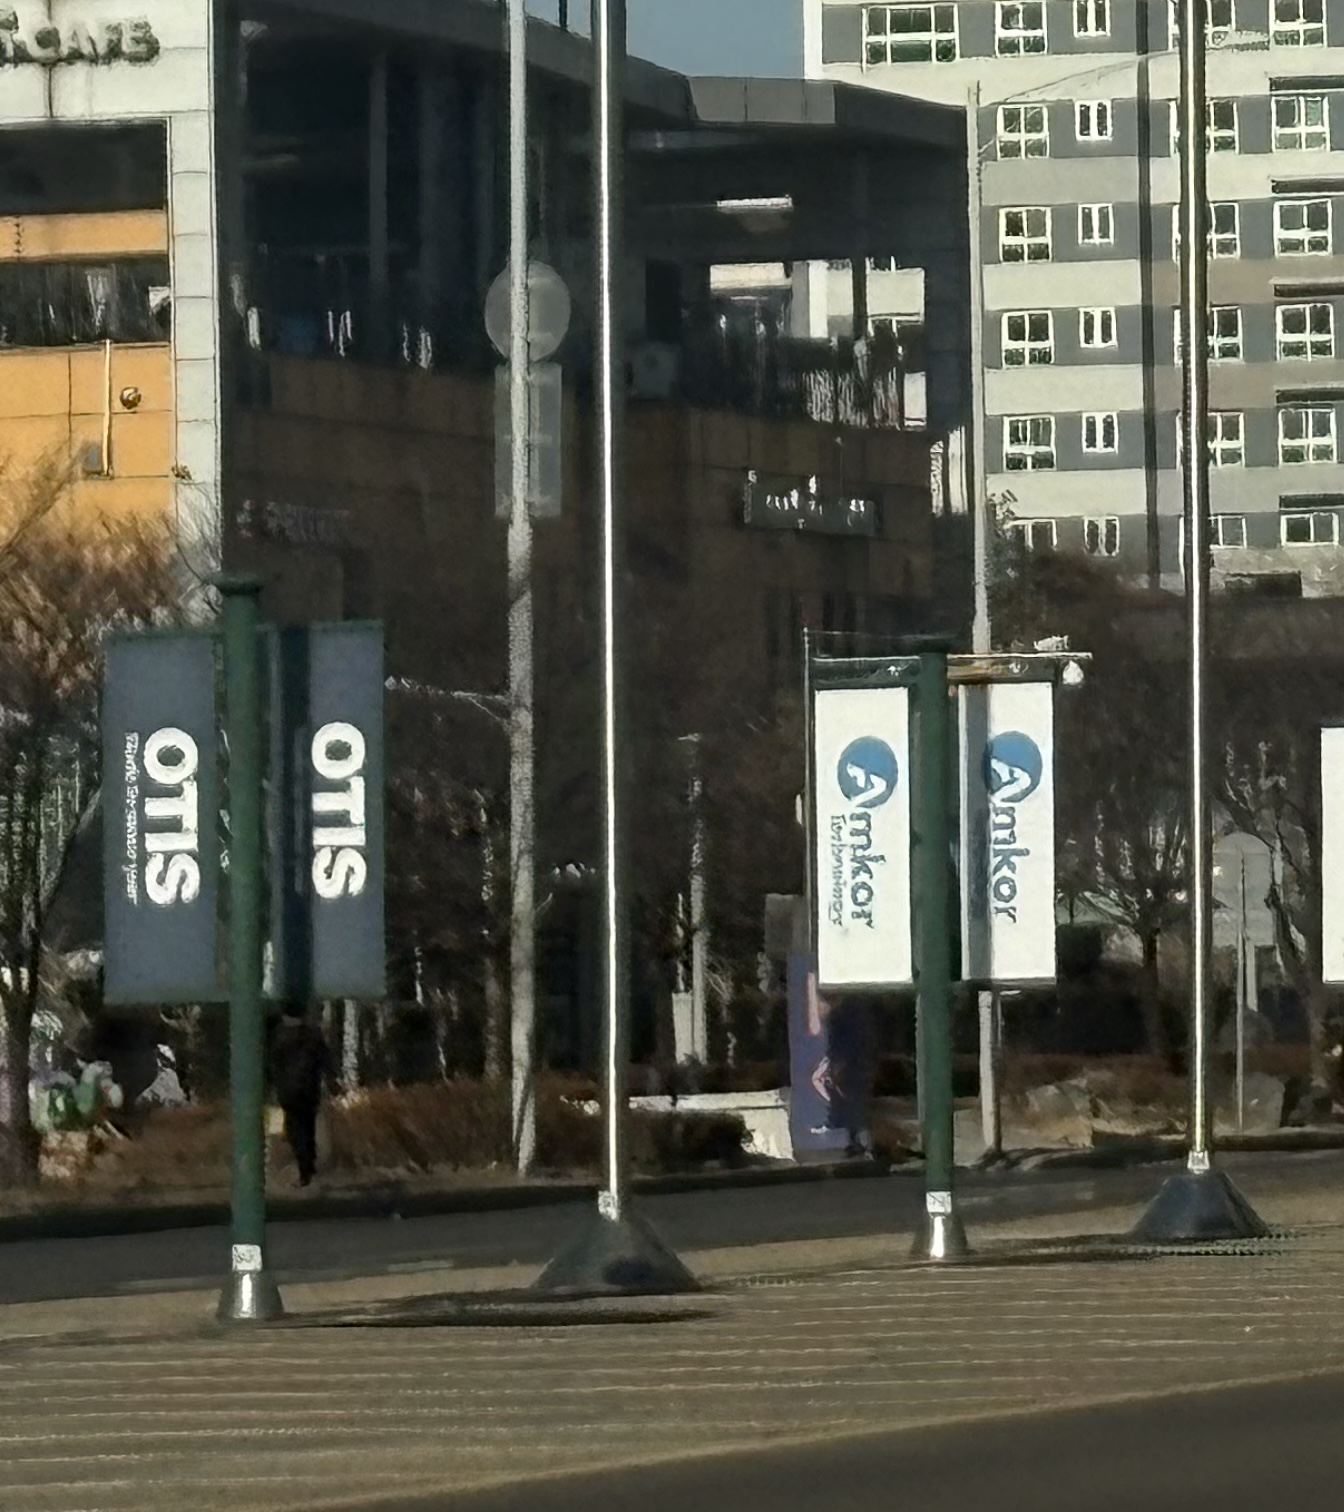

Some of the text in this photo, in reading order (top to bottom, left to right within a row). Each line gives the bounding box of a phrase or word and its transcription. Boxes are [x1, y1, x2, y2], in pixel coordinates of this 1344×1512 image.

[143, 727, 200, 905] OTIS
[311, 721, 367, 899] OTIS
[842, 746, 892, 928] Amkor
[987, 743, 1037, 923] Amkor
